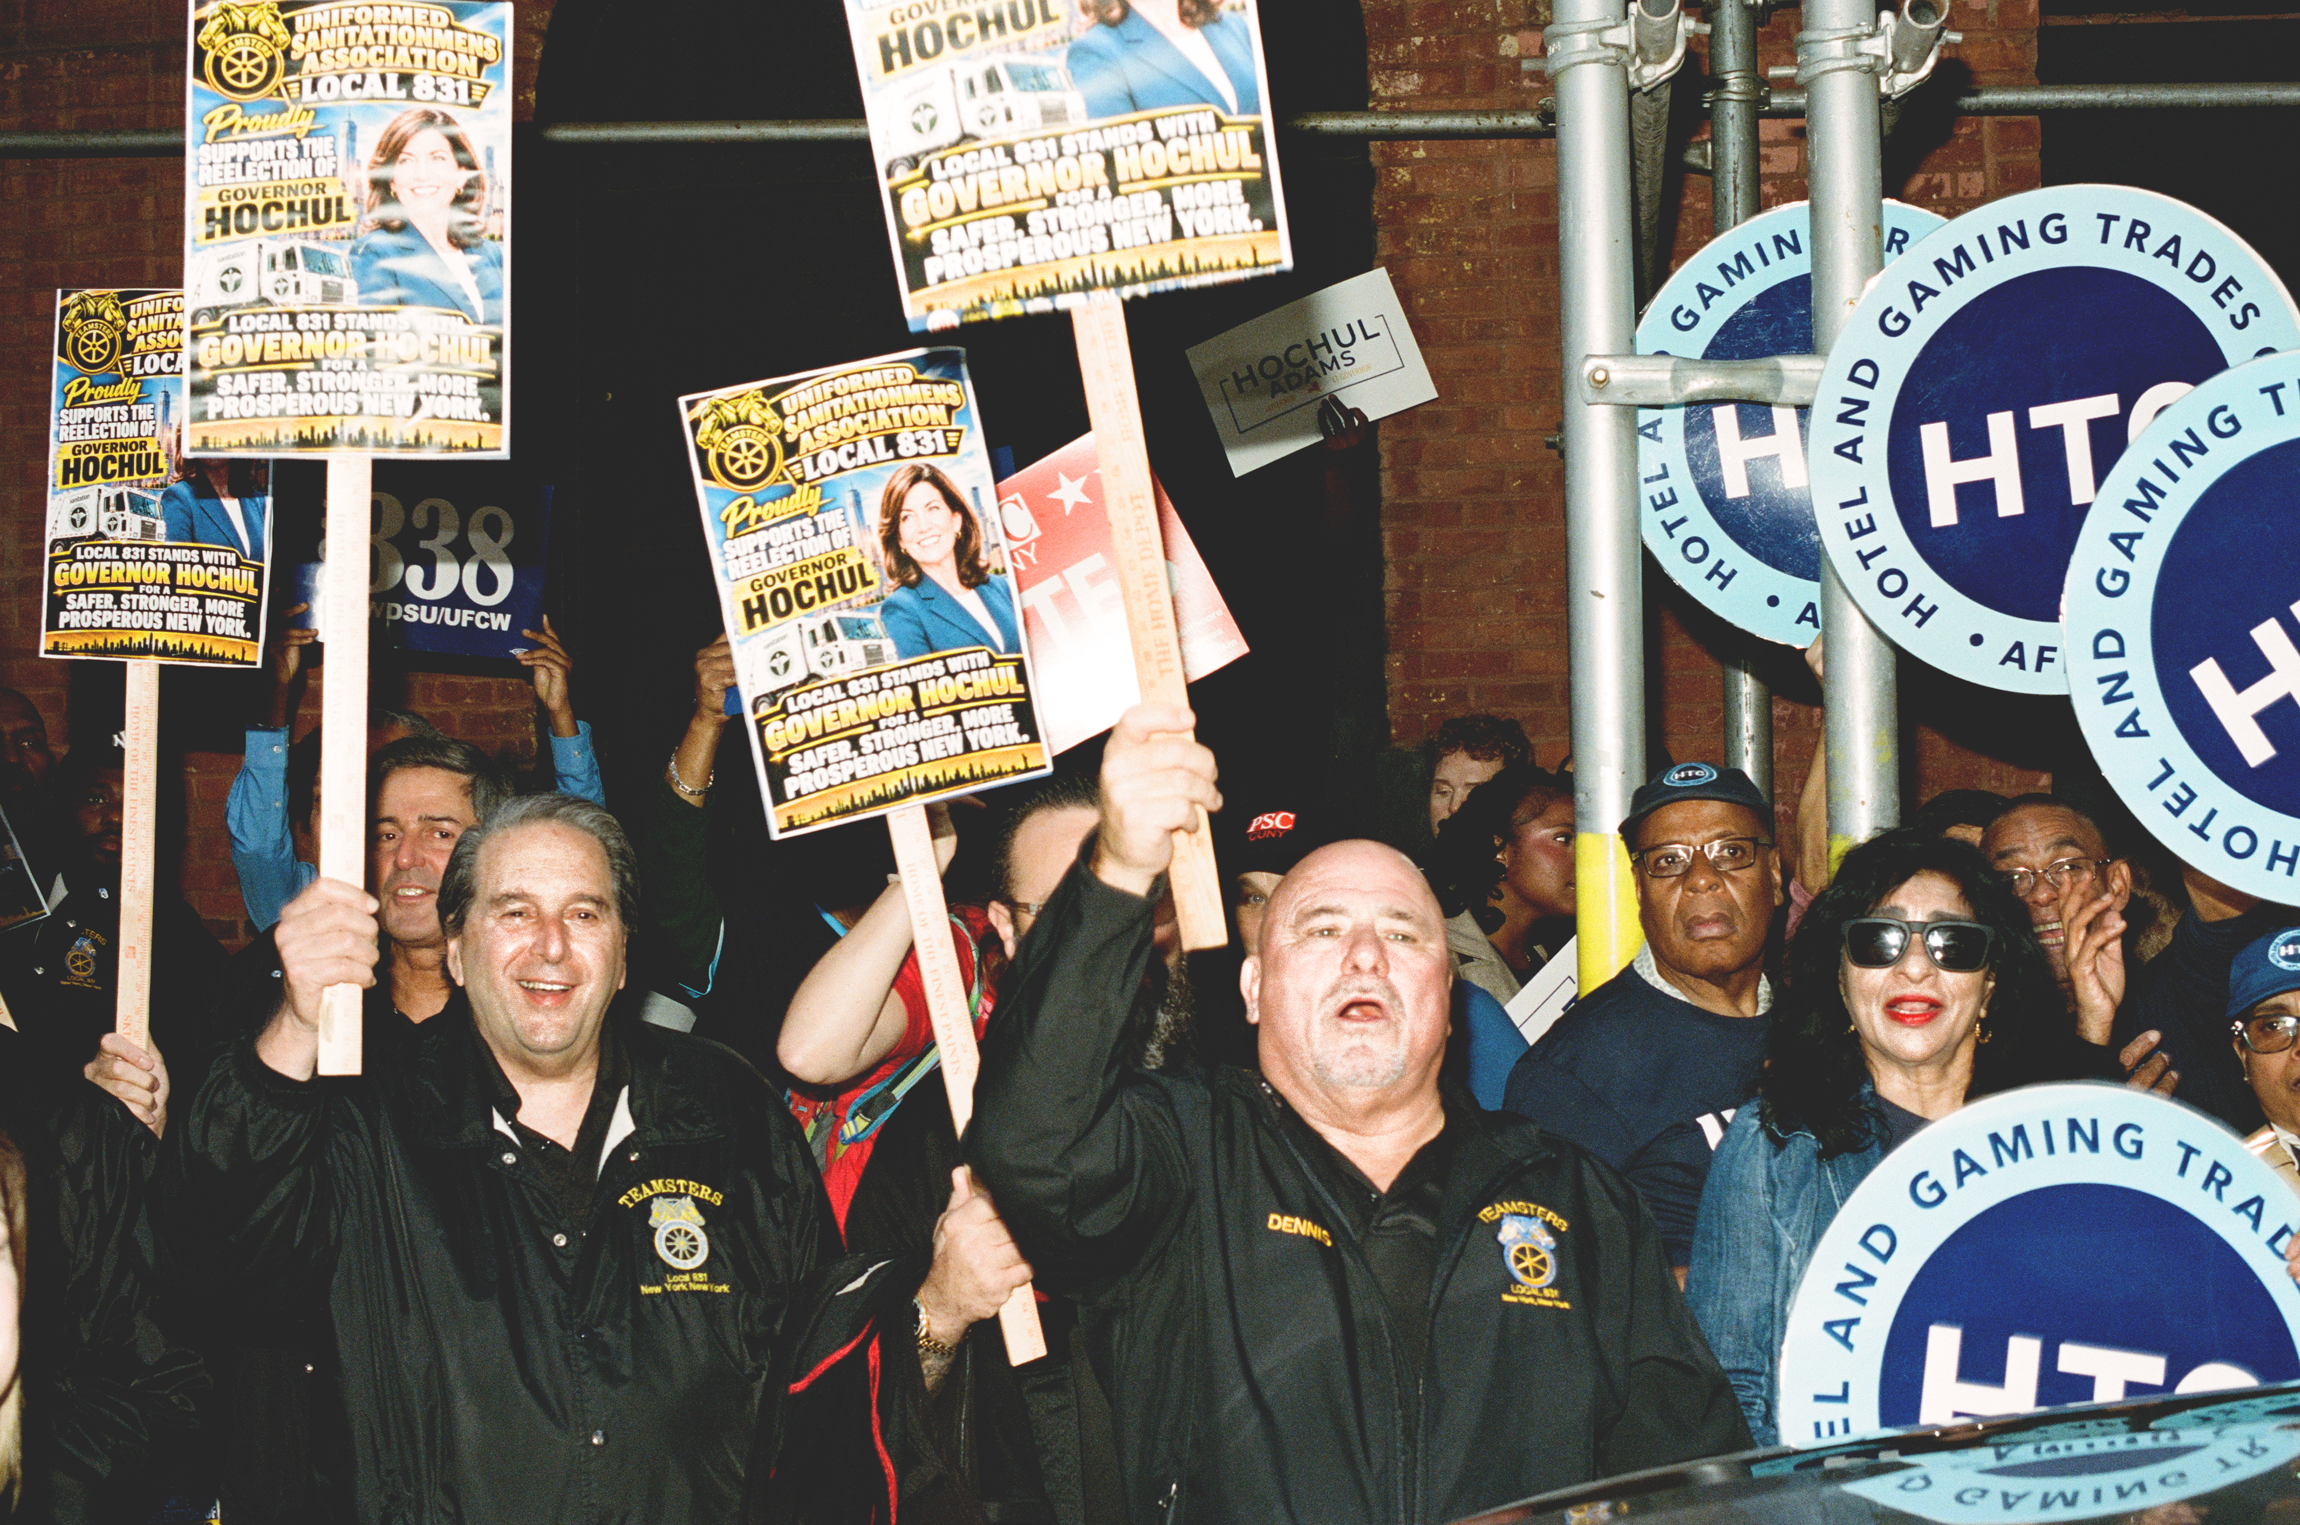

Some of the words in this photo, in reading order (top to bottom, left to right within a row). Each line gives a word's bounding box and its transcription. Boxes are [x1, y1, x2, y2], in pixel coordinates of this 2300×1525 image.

[294, 5, 450, 33] UNIFORMED
[217, 37, 273, 58] TEAMSTERS
[291, 25, 498, 62] SANITATIONMENS
[877, 0, 1060, 75] HOCHUL
[301, 45, 478, 77] ASSOCIATION
[301, 73, 407, 102] LOCAL
[413, 74, 470, 105] 831
[202, 103, 318, 143] Proudly
[198, 138, 300, 165] SUPPORTS
[301, 136, 335, 157] THE
[930, 146, 1012, 182] LOCAL
[1014, 139, 1058, 163] 831
[1060, 122, 1153, 158] STANDS
[1155, 111, 1216, 140] WITH
[198, 158, 314, 186] REELECTION
[314, 156, 338, 178] OF
[900, 154, 1109, 227] GOVERNOR
[1114, 131, 1261, 183] HOCHUL
[218, 182, 327, 203] GOVERNOR
[1055, 188, 1095, 207] FOR
[1098, 186, 1112, 201] A
[204, 196, 352, 239] HOCHUL
[930, 215, 1024, 256] SAFER,
[1027, 192, 1170, 236] STRONGER,
[1170, 180, 1243, 212] MORE
[924, 227, 1109, 286] PROSPEROUS
[1112, 213, 1171, 252] NEW
[1175, 203, 1263, 239] YORK.
[1670, 227, 1804, 333] GAMIN
[1878, 211, 2069, 339] GAMING
[2096, 212, 2262, 332] TRADES
[129, 297, 183, 318] UNIFO
[229, 314, 293, 333] LOCAL
[297, 314, 330, 332] 831
[334, 313, 411, 332] STANDS
[75, 322, 114, 339] TEAMSTERS
[198, 331, 367, 369] GOVERNOR
[375, 332, 497, 371] HOCHUL
[322, 360, 353, 372] FOR
[355, 360, 368, 372] A
[1232, 318, 1381, 394] HOCHUL
[63, 377, 143, 408] Proudly
[217, 372, 293, 396] SAFER,
[419, 374, 478, 397] MORE
[780, 367, 914, 417] UNIFORMED
[1269, 350, 1356, 399] ADAMS
[59, 405, 128, 425] SUPPORTS
[130, 404, 154, 420] THE
[207, 391, 359, 420] PROSPEROUS
[362, 392, 415, 417] NEW
[418, 395, 491, 423] YORK.
[783, 383, 961, 443] SANITATIONMENS
[1832, 357, 1880, 466] AND
[58, 421, 142, 442] REELECTION
[142, 421, 156, 437] OF
[717, 428, 770, 454] TEAMSTERS
[799, 404, 949, 454] ASSOCIATION
[71, 440, 148, 456] GOVERNOR
[803, 442, 895, 481] LOCAL
[897, 428, 949, 458] 831
[62, 452, 164, 486] HOCHUL
[719, 485, 822, 540] Proudly
[2095, 403, 2243, 600] GAMING
[722, 516, 815, 561] SUPPORTS
[815, 507, 847, 533] THE
[1643, 461, 1739, 592] HOTEL
[76, 547, 119, 560] LOCAL
[122, 547, 146, 560] 831
[148, 547, 200, 563] STANDS
[202, 551, 236, 566] WITH
[726, 535, 831, 582] REELECTION
[831, 526, 852, 552] OF
[1838, 485, 1939, 630] HOTEL
[54, 561, 171, 587] GOVERNOR
[176, 563, 258, 597] HOCHUL
[139, 585, 160, 594] FOR
[162, 586, 171, 595] A
[749, 552, 848, 594] GOVERNOR
[66, 594, 117, 611] SAFER,
[120, 594, 203, 615] STRONGER,
[205, 598, 245, 617] MORE
[742, 562, 875, 632] HOCHUL
[58, 611, 163, 630] PROSPEROUS
[166, 612, 202, 632] NEW
[205, 615, 252, 639] YORK.
[370, 602, 512, 632] WDSU/UFCW
[787, 688, 847, 714] LOCAL
[847, 680, 880, 697] 831
[880, 664, 945, 691] STANDS
[946, 651, 990, 675] WITH
[2091, 627, 2152, 740] AND
[130, 705, 141, 746] HOME
[764, 688, 916, 751] GOVERNOR
[918, 665, 1025, 715] HOCHUL
[879, 717, 904, 731] FOR
[905, 713, 920, 725] A
[129, 747, 140, 767] OF
[788, 741, 858, 775] SAFER,
[859, 717, 961, 757] STRONGER,
[960, 703, 1014, 733] MORE
[783, 746, 919, 801] PROSPEROUS
[920, 734, 964, 764] NEW
[965, 722, 1030, 752] YORK.
[1674, 769, 1706, 780] HTC
[129, 768, 139, 795] THE
[127, 797, 138, 846] FINEST
[1246, 812, 1295, 833] PSC
[2146, 757, 2300, 877] HOTEL
[1248, 829, 1287, 842] CUNY
[126, 847, 137, 893] PAINTS
[618, 1178, 724, 1209] TEAMSTERS
[1267, 1213, 1333, 1248] DENNIS
[1475, 1200, 1569, 1232] TEAMSTERS
[1821, 1221, 1900, 1353] AND
[1908, 1116, 2145, 1211] GAMING
[2175, 1139, 2300, 1262] TRAD
[640, 1284, 662, 1295] New
[666, 1273, 690, 1283] Local
[692, 1272, 708, 1283] 831
